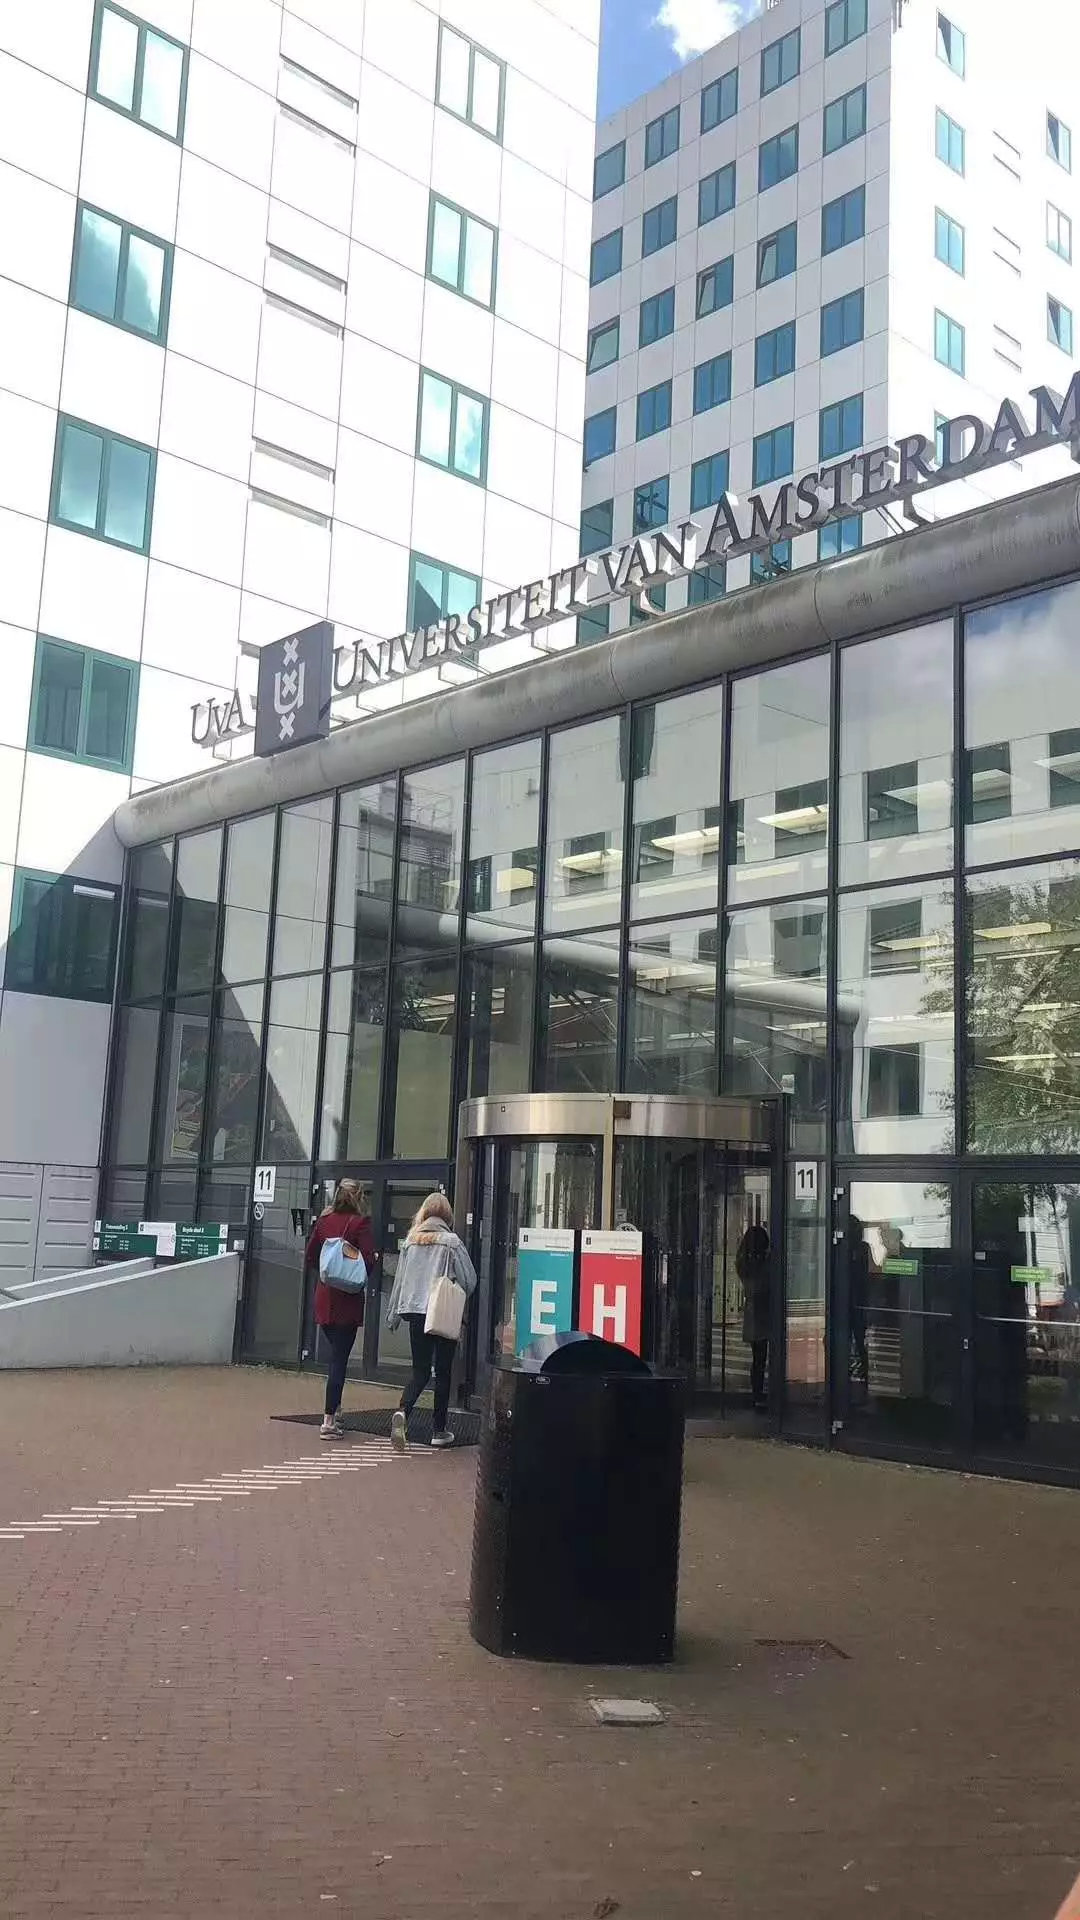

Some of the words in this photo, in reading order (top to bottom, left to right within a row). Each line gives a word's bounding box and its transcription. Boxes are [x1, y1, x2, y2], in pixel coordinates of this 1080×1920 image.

[332, 559, 588, 692] UNIVERSITEIT
[599, 521, 697, 590] VAN
[699, 369, 1080, 558] AMSTERDAM
[258, 1170, 272, 1191] 11
[797, 1168, 814, 1189] 11
[530, 1279, 558, 1335] E
[592, 1283, 627, 1343] H
